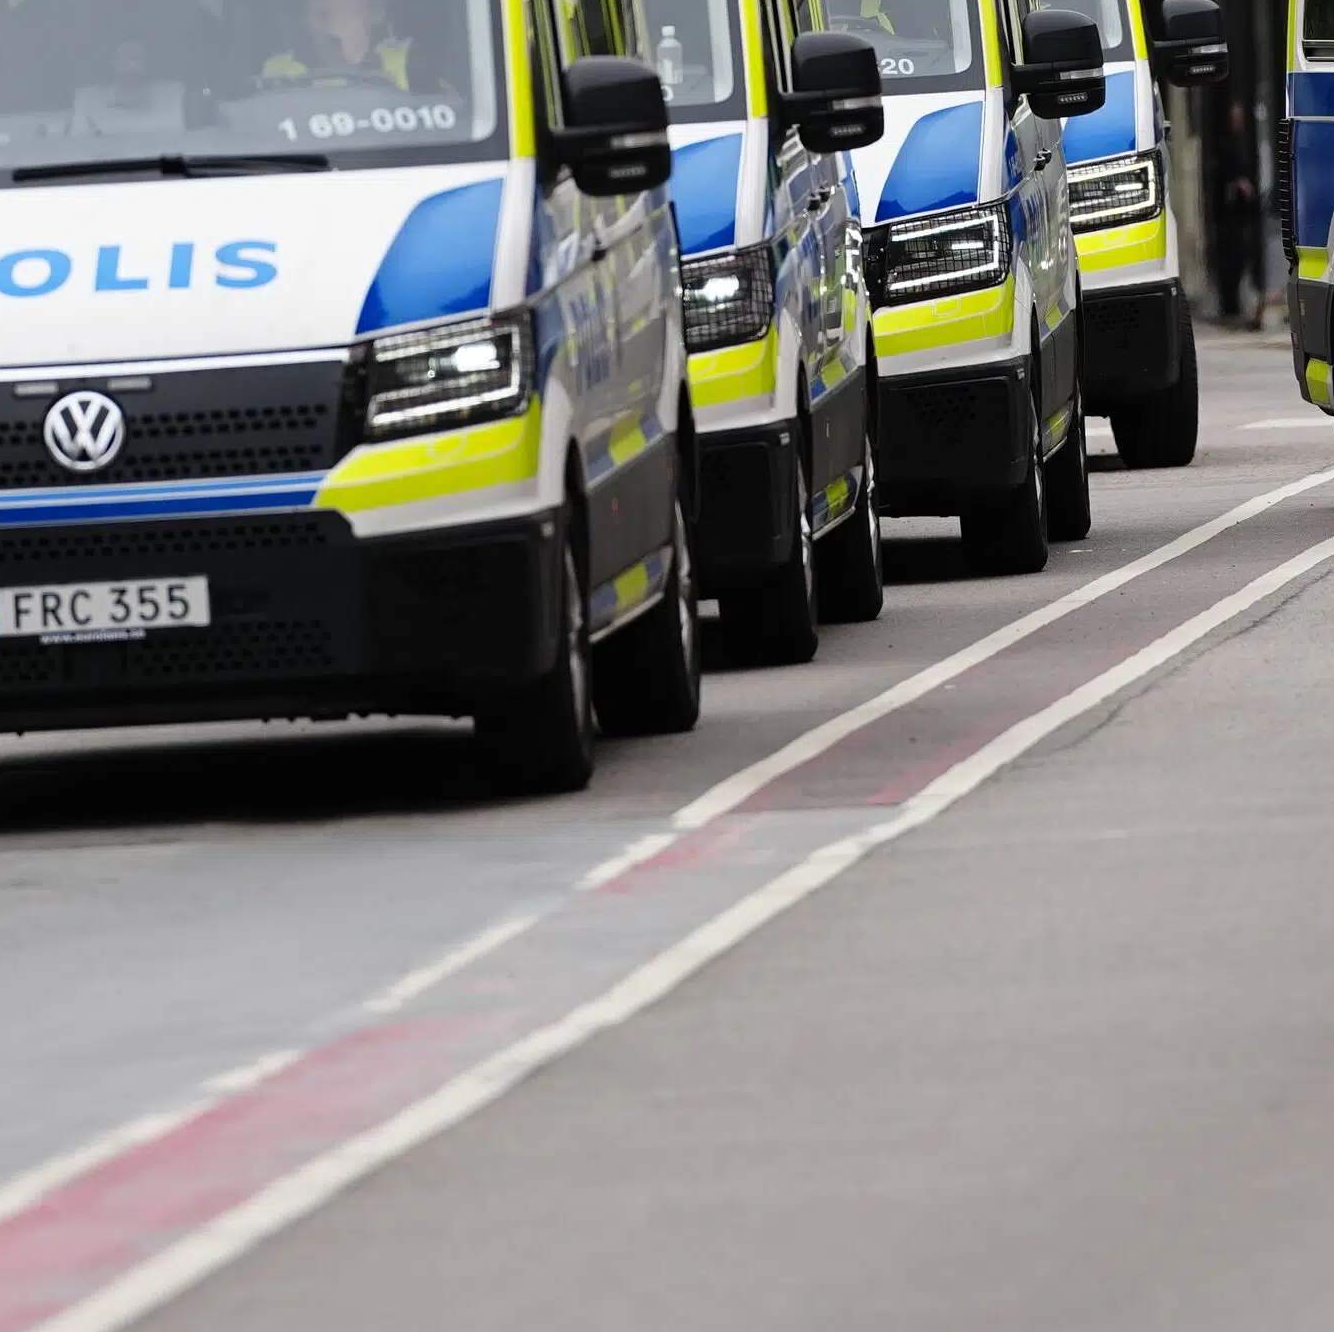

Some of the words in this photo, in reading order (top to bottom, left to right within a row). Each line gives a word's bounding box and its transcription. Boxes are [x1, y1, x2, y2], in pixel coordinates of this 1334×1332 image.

[278, 117, 298, 142] 1
[308, 104, 456, 139] 69-0010
[13, 590, 92, 629] FRC
[109, 584, 189, 624] 355
